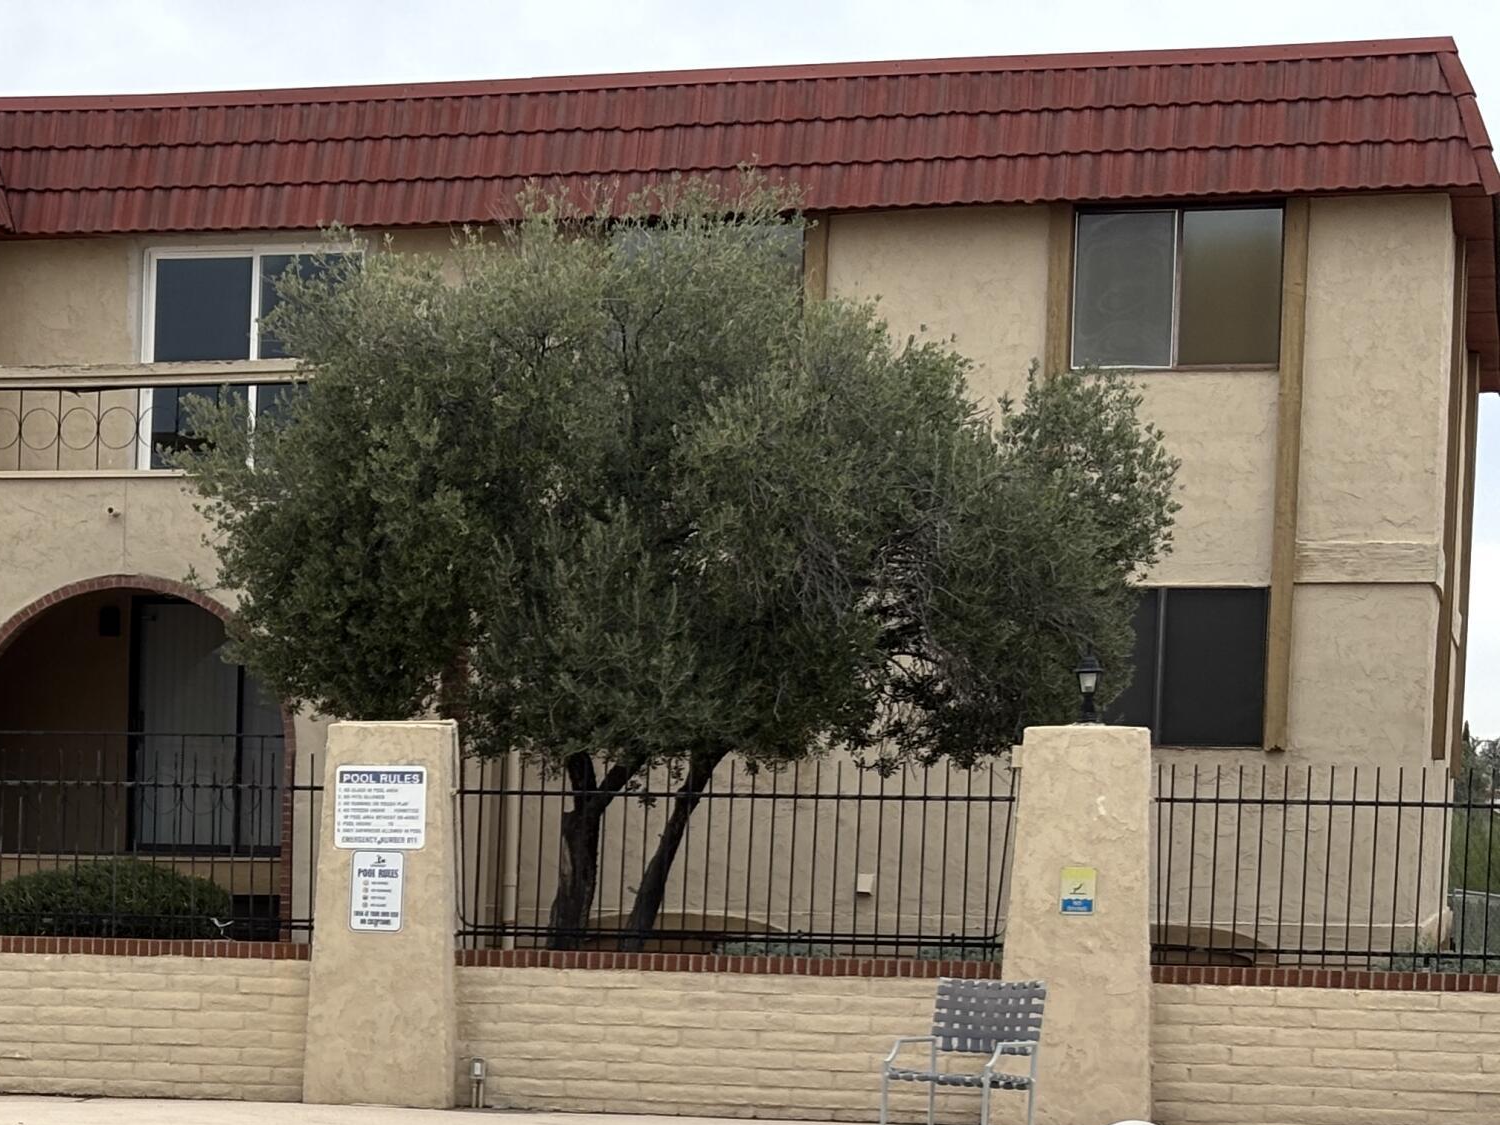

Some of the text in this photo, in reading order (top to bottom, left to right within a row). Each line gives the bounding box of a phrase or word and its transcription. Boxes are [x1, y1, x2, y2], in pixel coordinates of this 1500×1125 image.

[342, 773, 420, 785] POOL RULES
[357, 868, 376, 878] POOL
